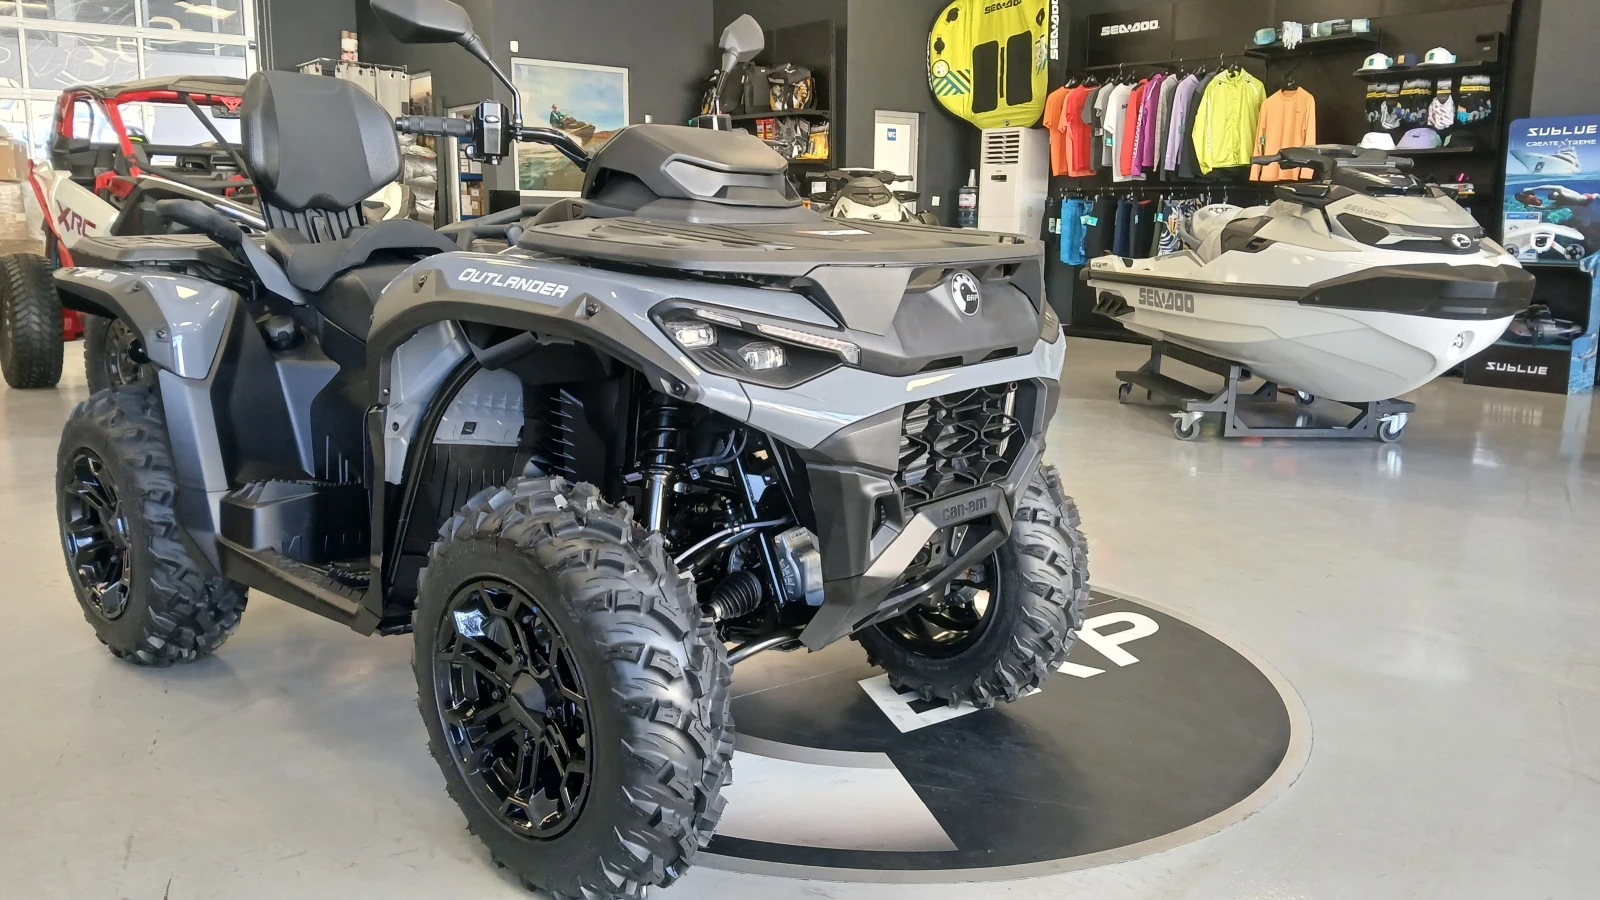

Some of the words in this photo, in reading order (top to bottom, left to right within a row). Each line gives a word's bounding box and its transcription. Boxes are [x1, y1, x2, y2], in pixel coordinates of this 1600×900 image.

[57, 201, 97, 238] XRC
[457, 267, 570, 299] OUTLANDER
[942, 496, 988, 521] can-am
